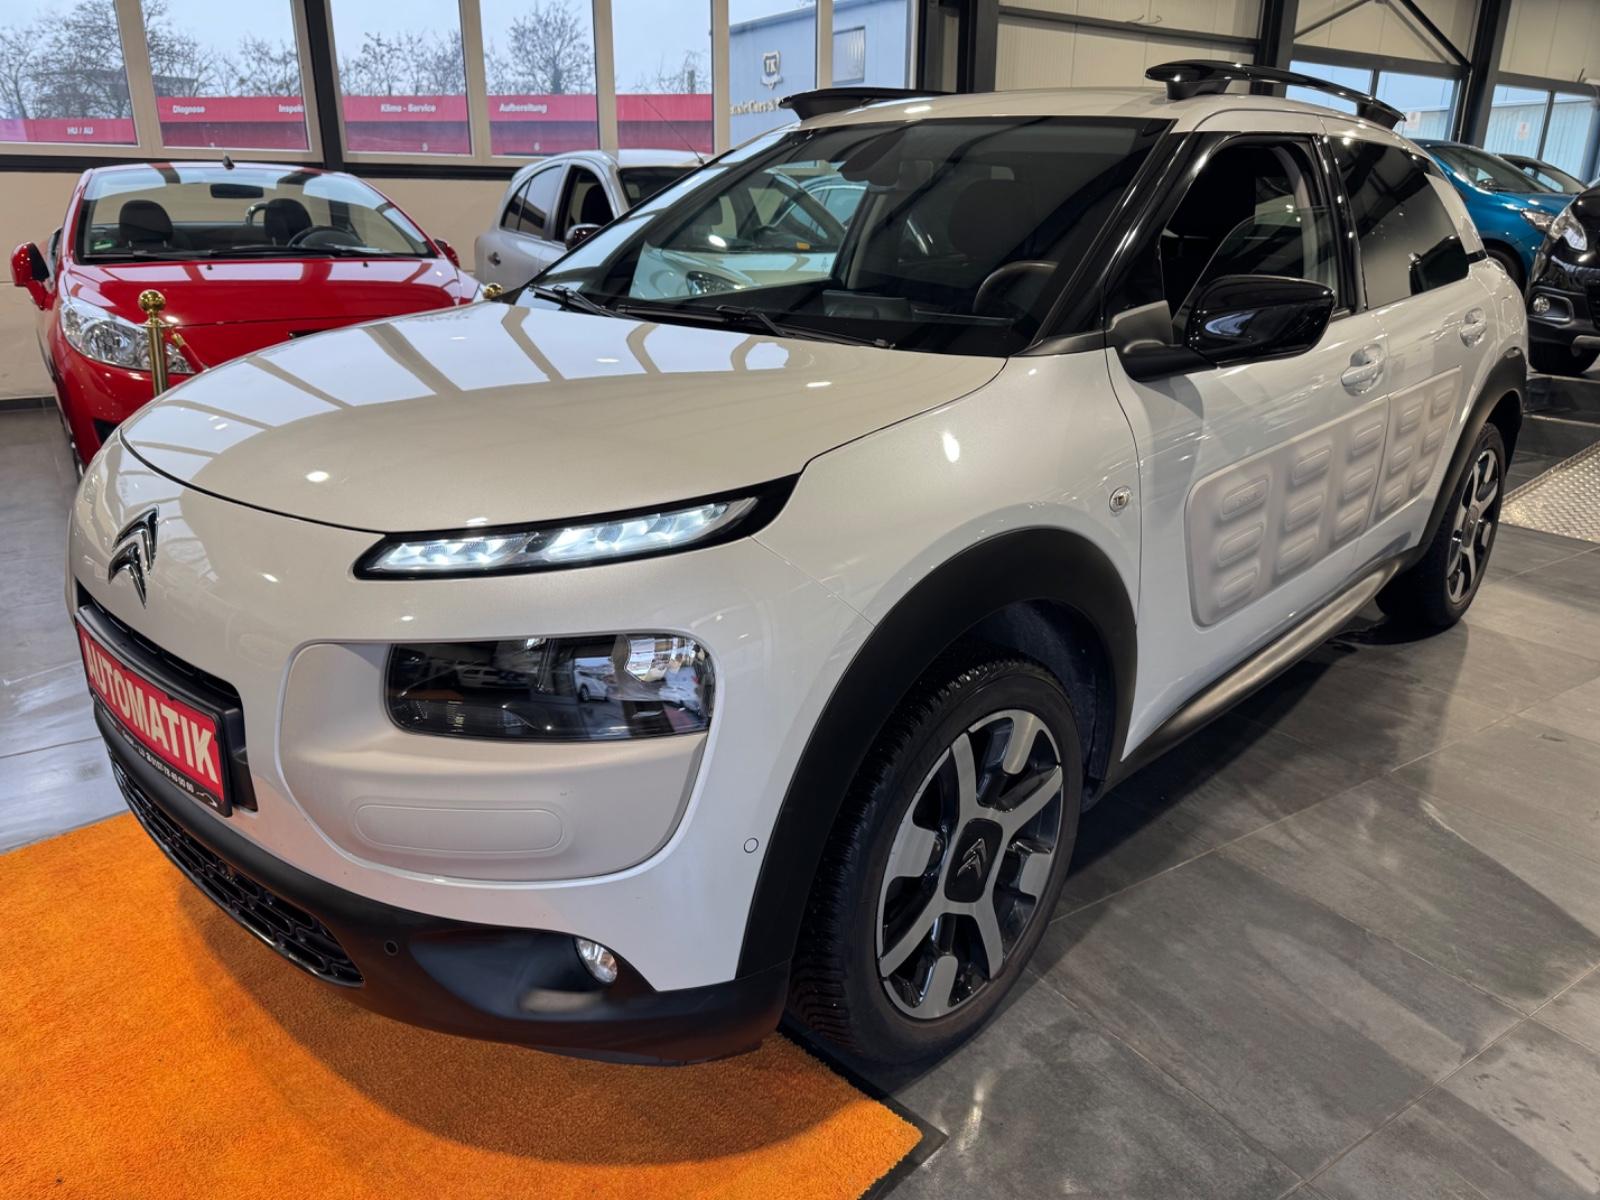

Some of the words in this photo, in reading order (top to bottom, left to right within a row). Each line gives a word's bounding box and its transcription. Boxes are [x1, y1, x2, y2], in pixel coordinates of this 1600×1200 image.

[172, 104, 205, 115] Diagnose
[408, 103, 436, 112] Service
[499, 103, 547, 114] Aufbereitung
[83, 637, 219, 785] AUTOMATIK
